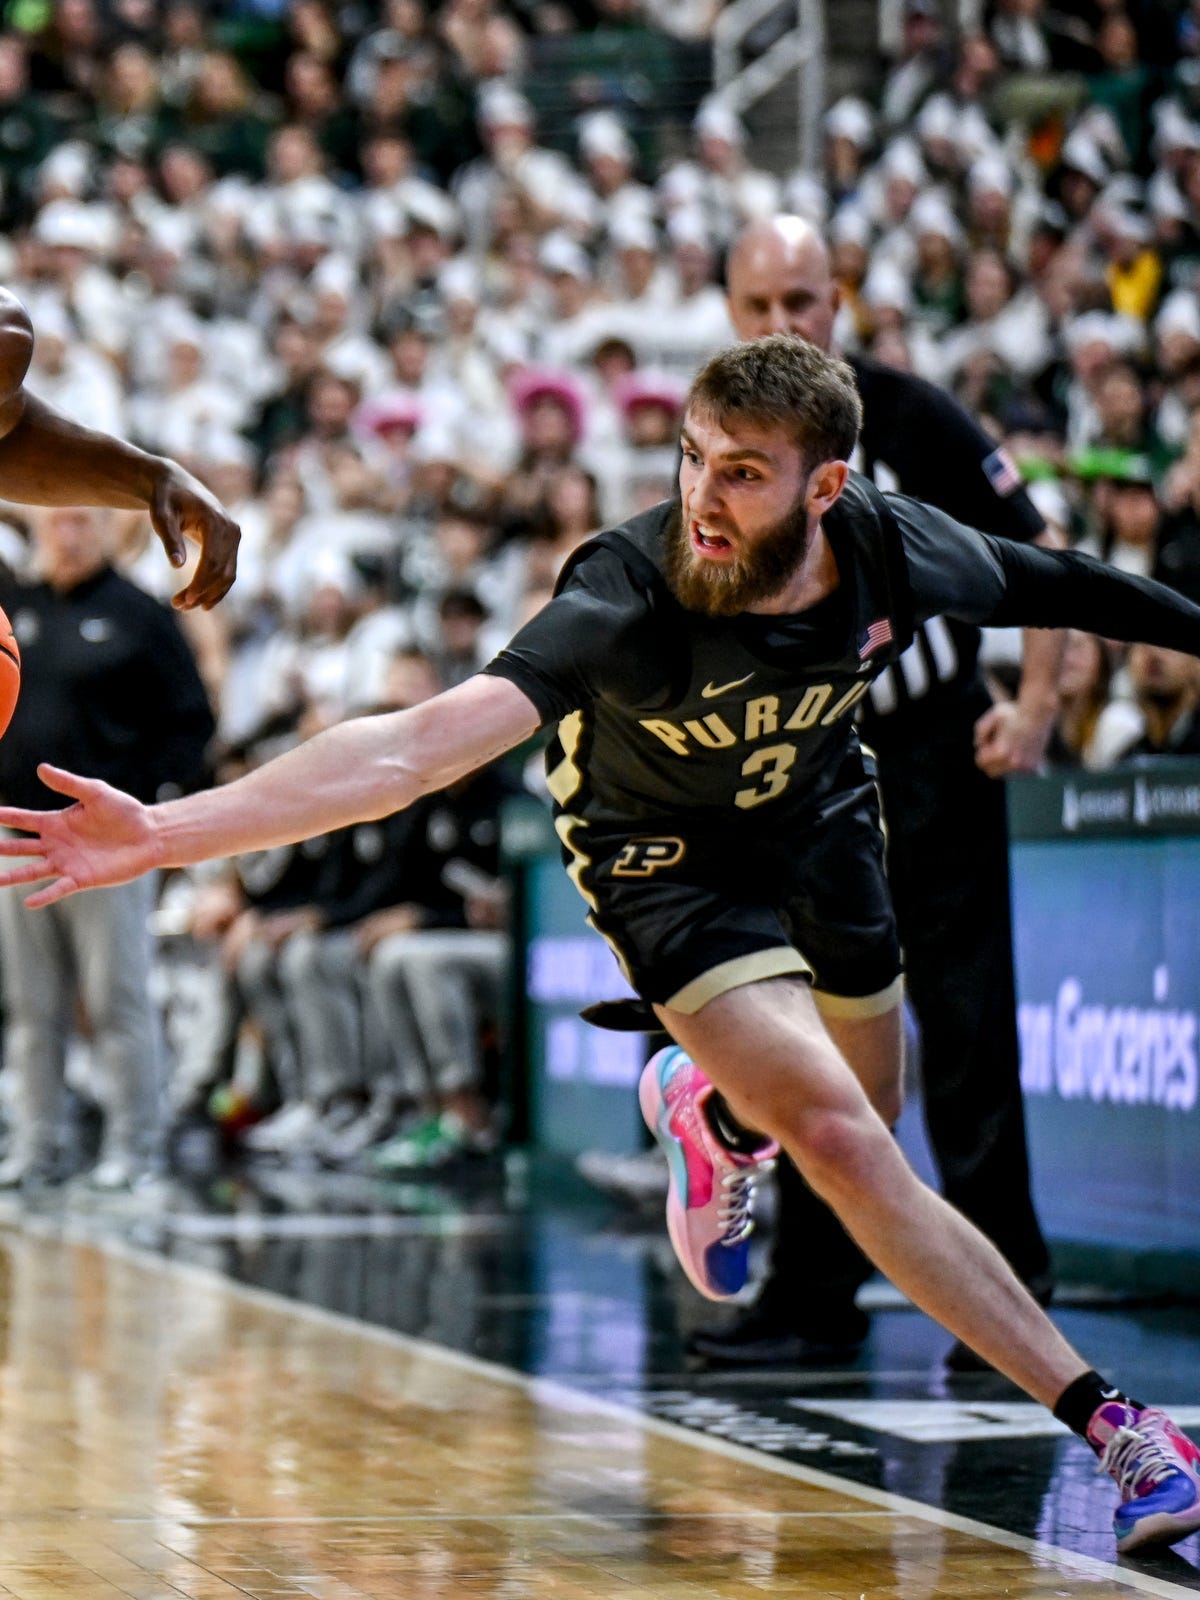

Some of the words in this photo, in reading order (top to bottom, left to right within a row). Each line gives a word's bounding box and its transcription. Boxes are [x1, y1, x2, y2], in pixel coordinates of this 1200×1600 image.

[638, 680, 873, 757] PURDU
[734, 743, 797, 811] 3
[611, 837, 686, 876] P
[1055, 965, 1197, 1112] Groceries
